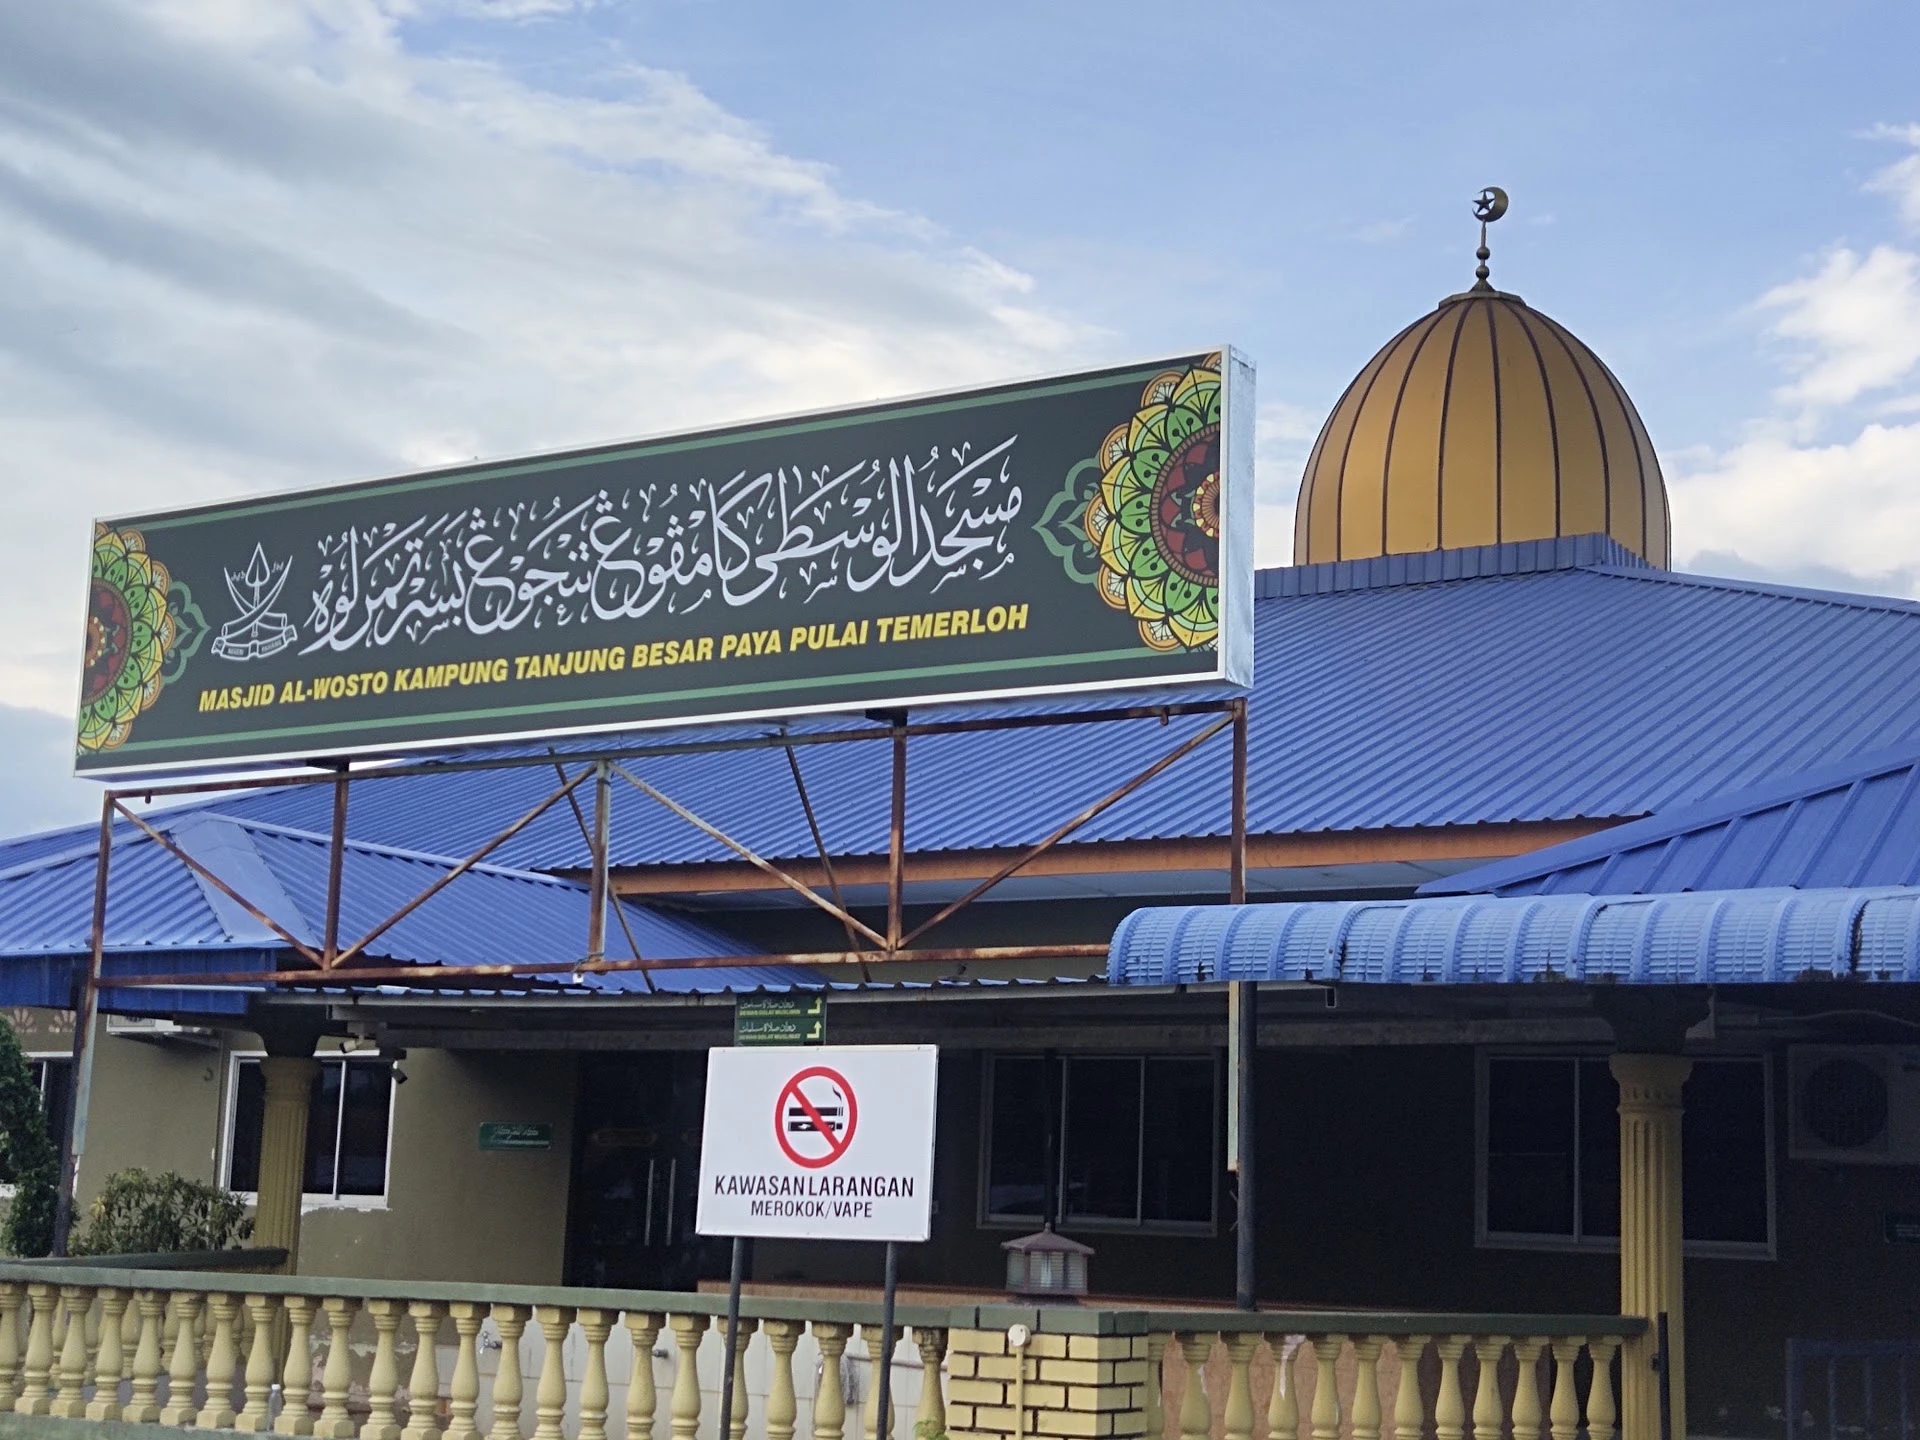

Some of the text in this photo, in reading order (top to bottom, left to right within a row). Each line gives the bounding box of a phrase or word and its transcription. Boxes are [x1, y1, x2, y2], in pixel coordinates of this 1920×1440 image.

[889, 436, 1023, 592] مسجد
[199, 603, 1029, 711] MASJID AL-WOSTO KAMPUNG TANJUNG BESAR PAYA PULAI TEMERLOH
[714, 1175, 914, 1198] KAWASAN LARANGAN
[751, 1200, 873, 1219] MEROKOK/VAPE
